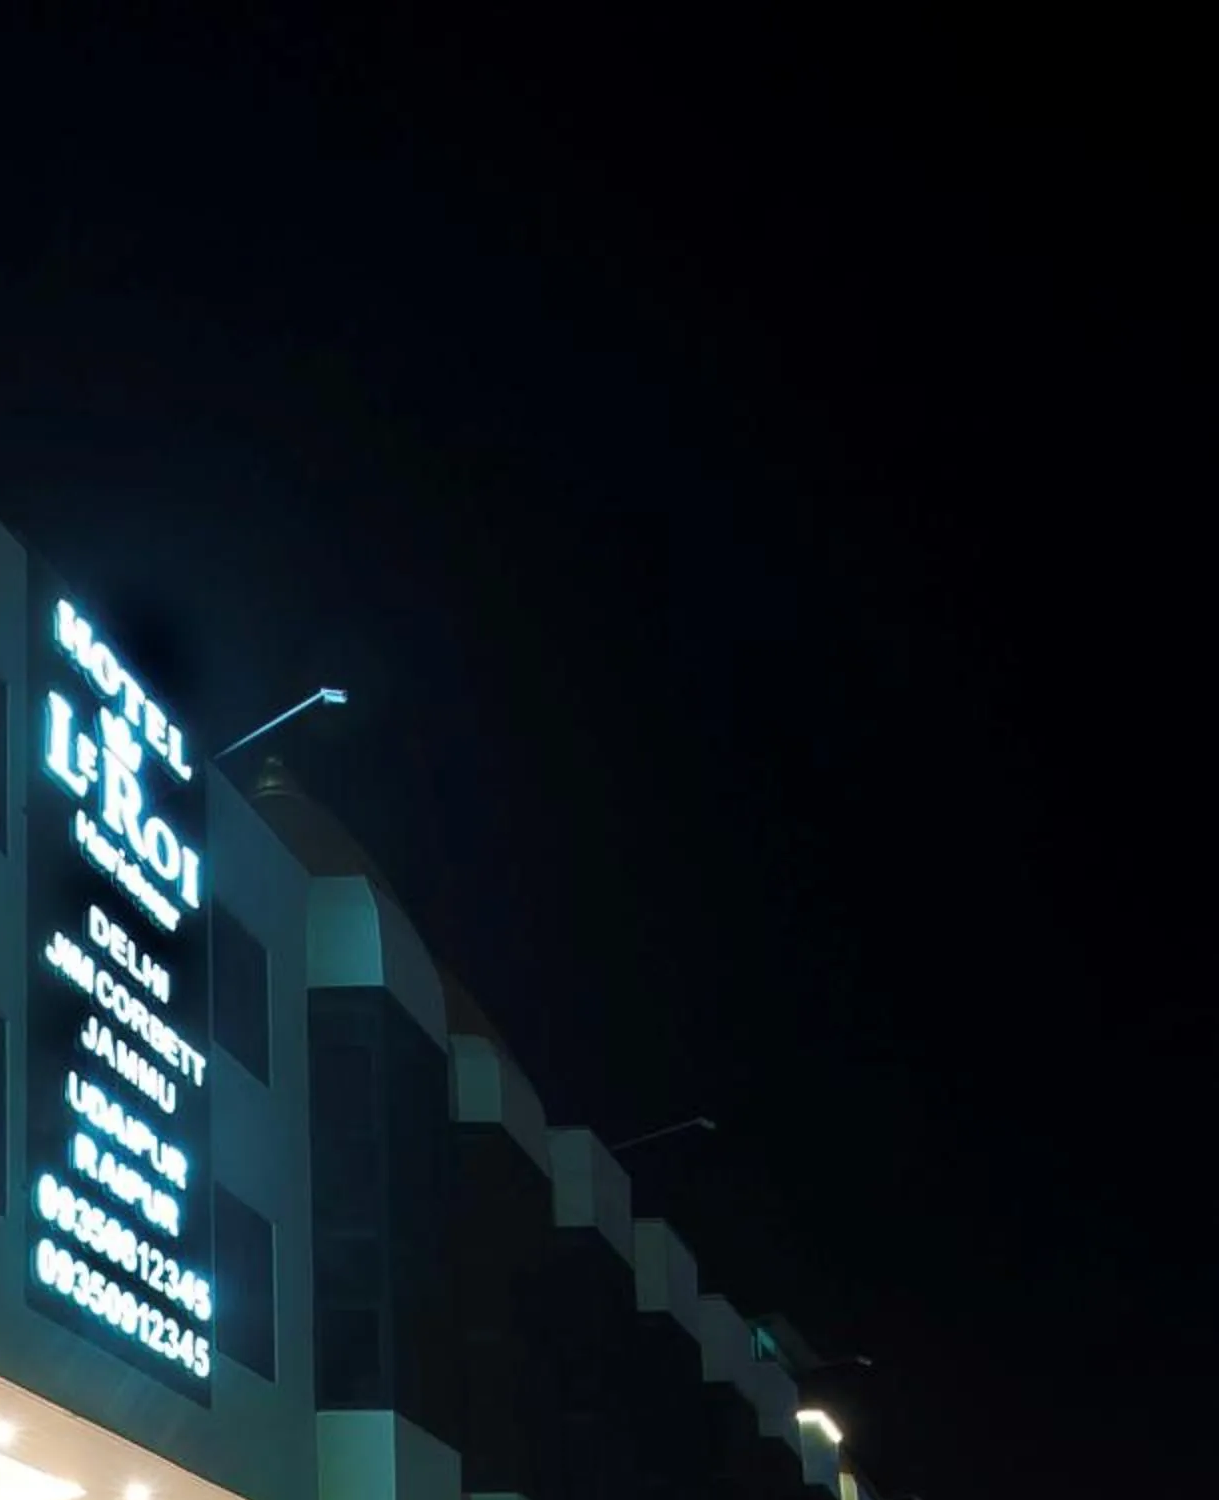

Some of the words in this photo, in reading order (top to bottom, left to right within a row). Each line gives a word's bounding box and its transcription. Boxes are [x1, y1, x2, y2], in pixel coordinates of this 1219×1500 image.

[57, 599, 192, 781] HOTEL
[46, 691, 98, 797] LE
[101, 747, 200, 909] ROI
[76, 809, 181, 931] Haridwar
[45, 931, 95, 994] JIM
[95, 970, 206, 1087] CORBETT
[89, 905, 170, 1004] DELHI
[81, 1016, 176, 1114] JAMMU
[68, 1071, 188, 1190] UDAIPUR
[74, 1133, 179, 1237] RAIPUR
